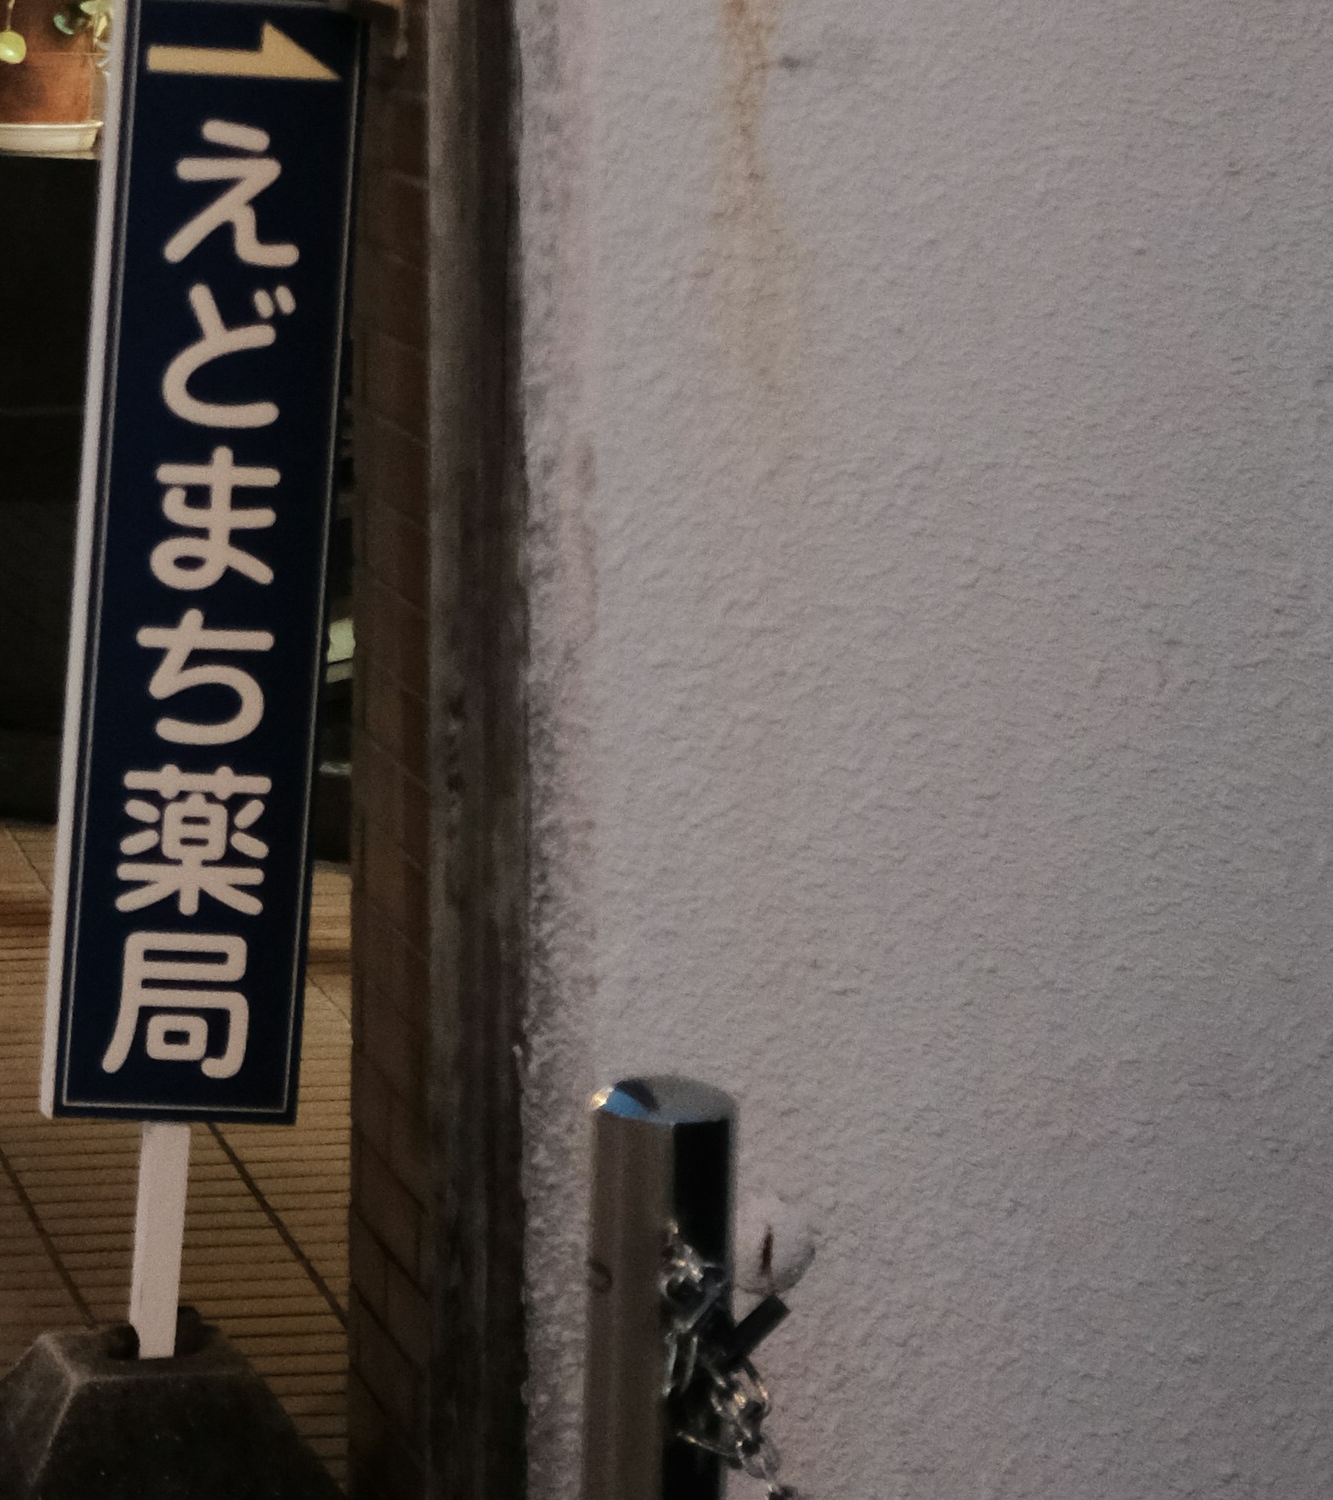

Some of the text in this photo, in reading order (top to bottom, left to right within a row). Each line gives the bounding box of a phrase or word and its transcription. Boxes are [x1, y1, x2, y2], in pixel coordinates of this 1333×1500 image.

[101, 118, 301, 1080] えどまち薬局
